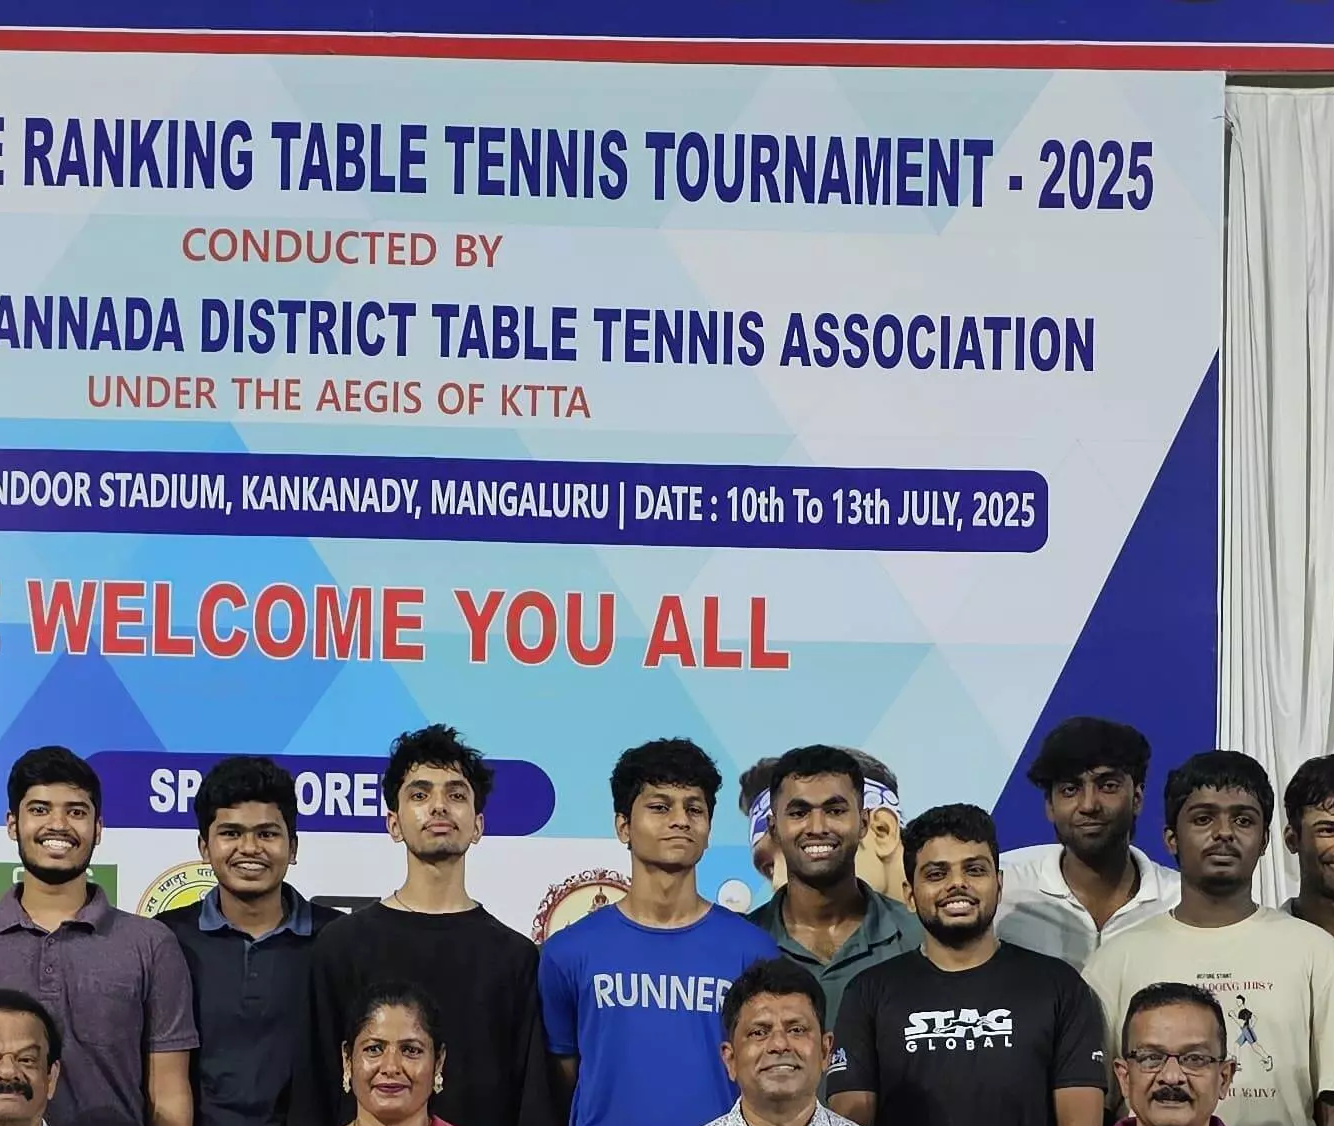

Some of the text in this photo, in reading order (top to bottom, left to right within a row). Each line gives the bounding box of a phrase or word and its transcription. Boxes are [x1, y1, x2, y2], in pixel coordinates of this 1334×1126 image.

[26, 117, 253, 191] RANKING
[272, 121, 428, 195] TABLE
[445, 126, 628, 200] TENNIS
[646, 131, 994, 208] TOURNAMENT
[1008, 174, 1023, 190] -
[1039, 139, 1155, 211] 2025
[182, 227, 503, 268] CONDUCTED BY
[200, 299, 417, 358] DISTRICT
[432, 304, 577, 361] TABLE
[595, 308, 764, 367] TENNIS
[781, 313, 1095, 372] ASSOCIATION
[87, 376, 591, 418] UNDER THE AEGIS OF KTTA
[99, 473, 232, 516] STADIUM,
[243, 476, 422, 519] KANKANADY,
[431, 480, 610, 518] MANGALURU
[635, 485, 703, 521] DATE
[726, 486, 785, 524] 10th
[794, 488, 824, 525] To
[832, 488, 890, 526] 13th
[898, 490, 963, 533] JULY,
[973, 490, 1035, 529] 2025
[27, 580, 427, 661] WELCOME
[455, 589, 615, 668] YOU
[643, 595, 791, 670] ALL
[149, 768, 389, 817] SPORE
[904, 1009, 1012, 1040] STAG
[906, 1035, 1012, 1052] GLOBAL
